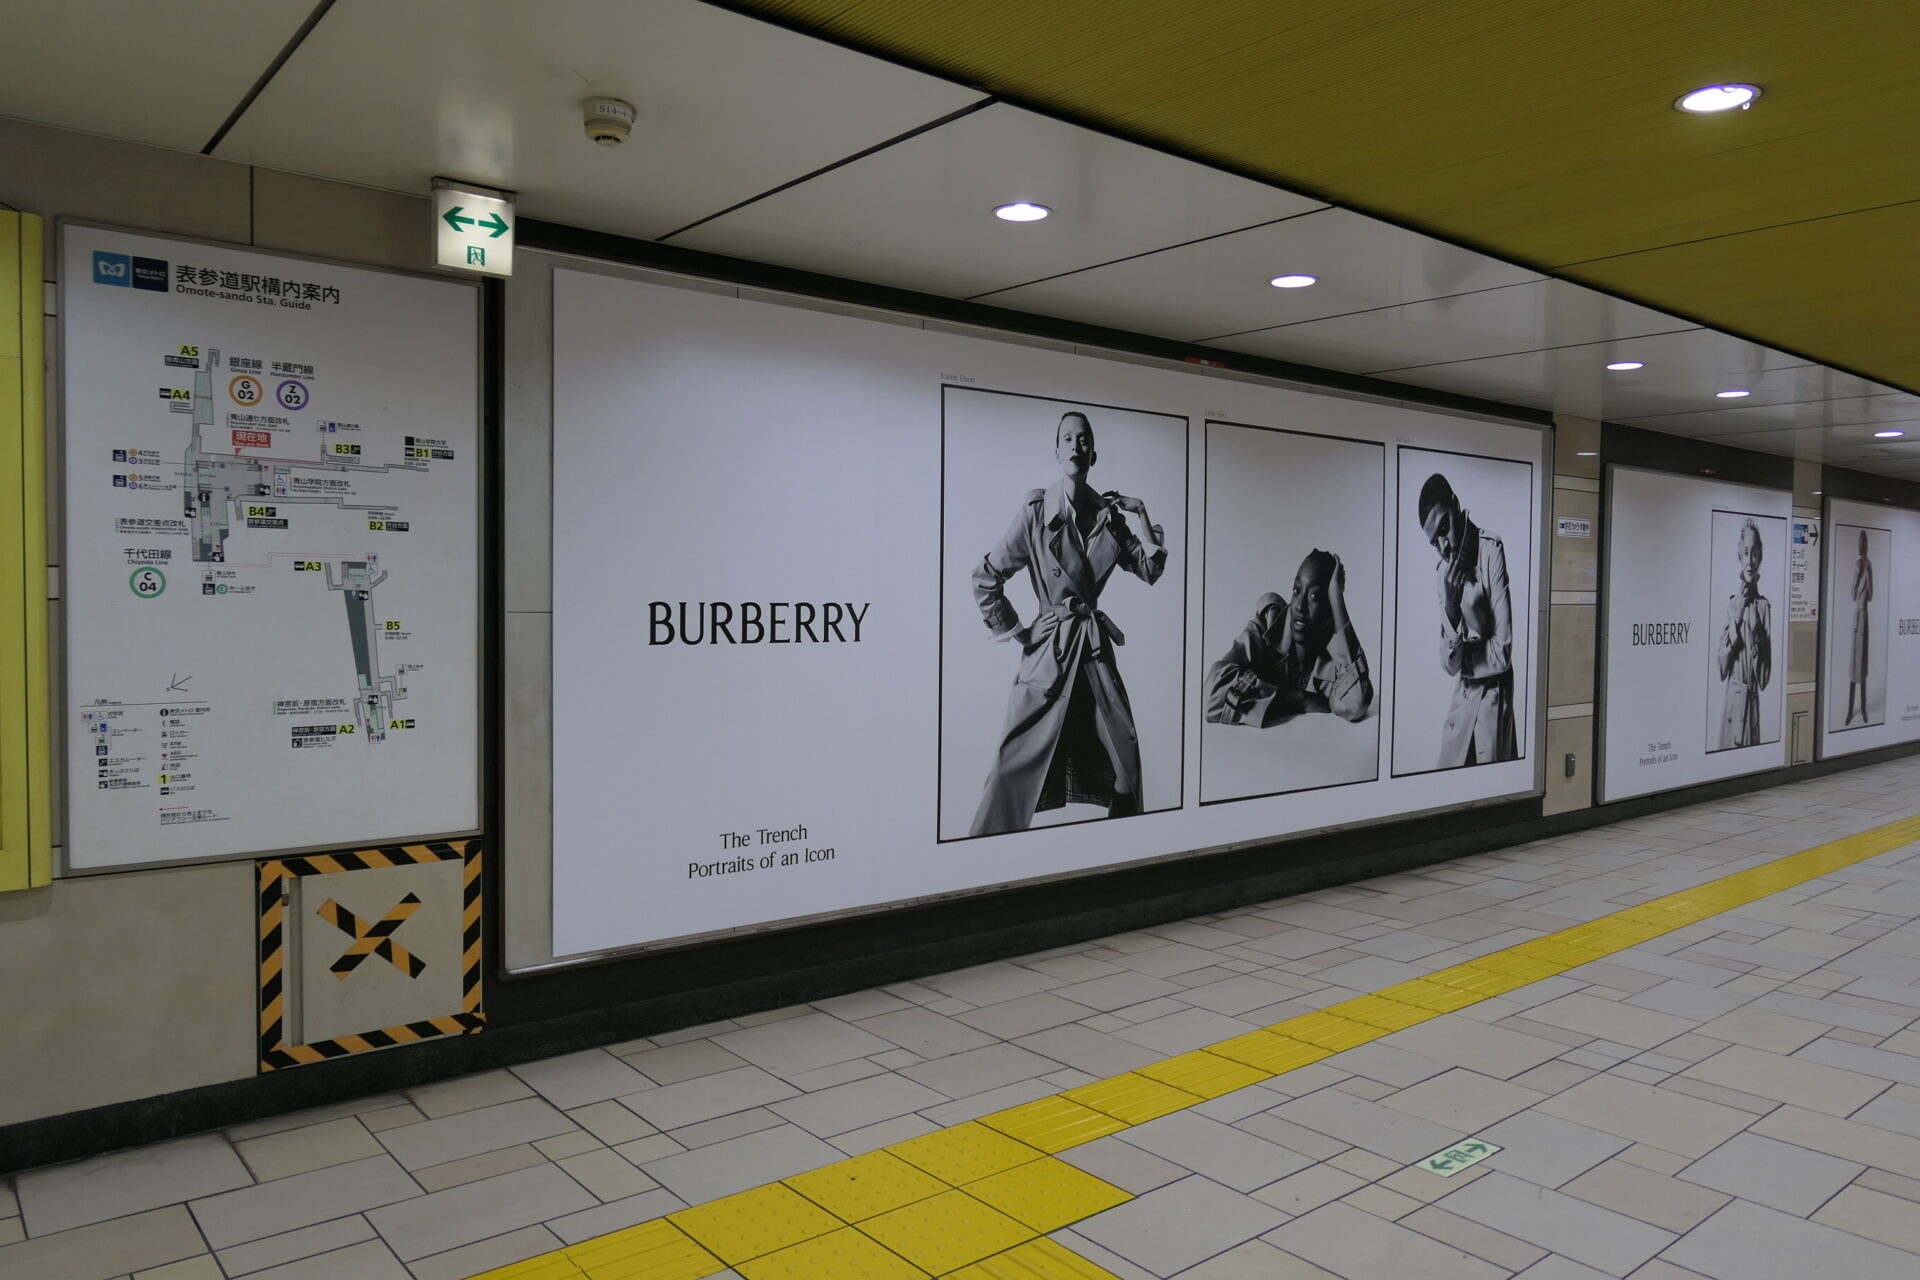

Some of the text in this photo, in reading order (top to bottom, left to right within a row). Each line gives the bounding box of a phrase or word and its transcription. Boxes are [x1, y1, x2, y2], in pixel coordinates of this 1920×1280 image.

[176, 264, 340, 304] 表参道駅構内案内
[176, 284, 311, 311] Omote-sando Sta. Guide
[180, 346, 199, 357] A5
[229, 356, 263, 370] 銀座線
[271, 361, 314, 375] 半蔵門線
[241, 381, 250, 389] G
[289, 385, 296, 393] Z
[172, 390, 191, 400] A4
[237, 391, 254, 400] 02
[284, 394, 300, 404] 02
[235, 431, 268, 443] 現在地
[335, 444, 350, 454] B3
[416, 448, 429, 458] B1
[249, 506, 265, 516] B4
[369, 521, 383, 530] B2
[123, 548, 172, 560] 千代田線
[305, 562, 322, 572] A3
[144, 572, 152, 581] C
[139, 582, 157, 592] 04
[386, 621, 401, 631] B5
[648, 601, 871, 645] BURBERRY
[1632, 622, 1691, 646] BURBERRY
[339, 724, 355, 734] A2
[390, 720, 405, 730] A1
[720, 824, 808, 850] The Trench
[688, 848, 835, 879] Portraits of an Icon
